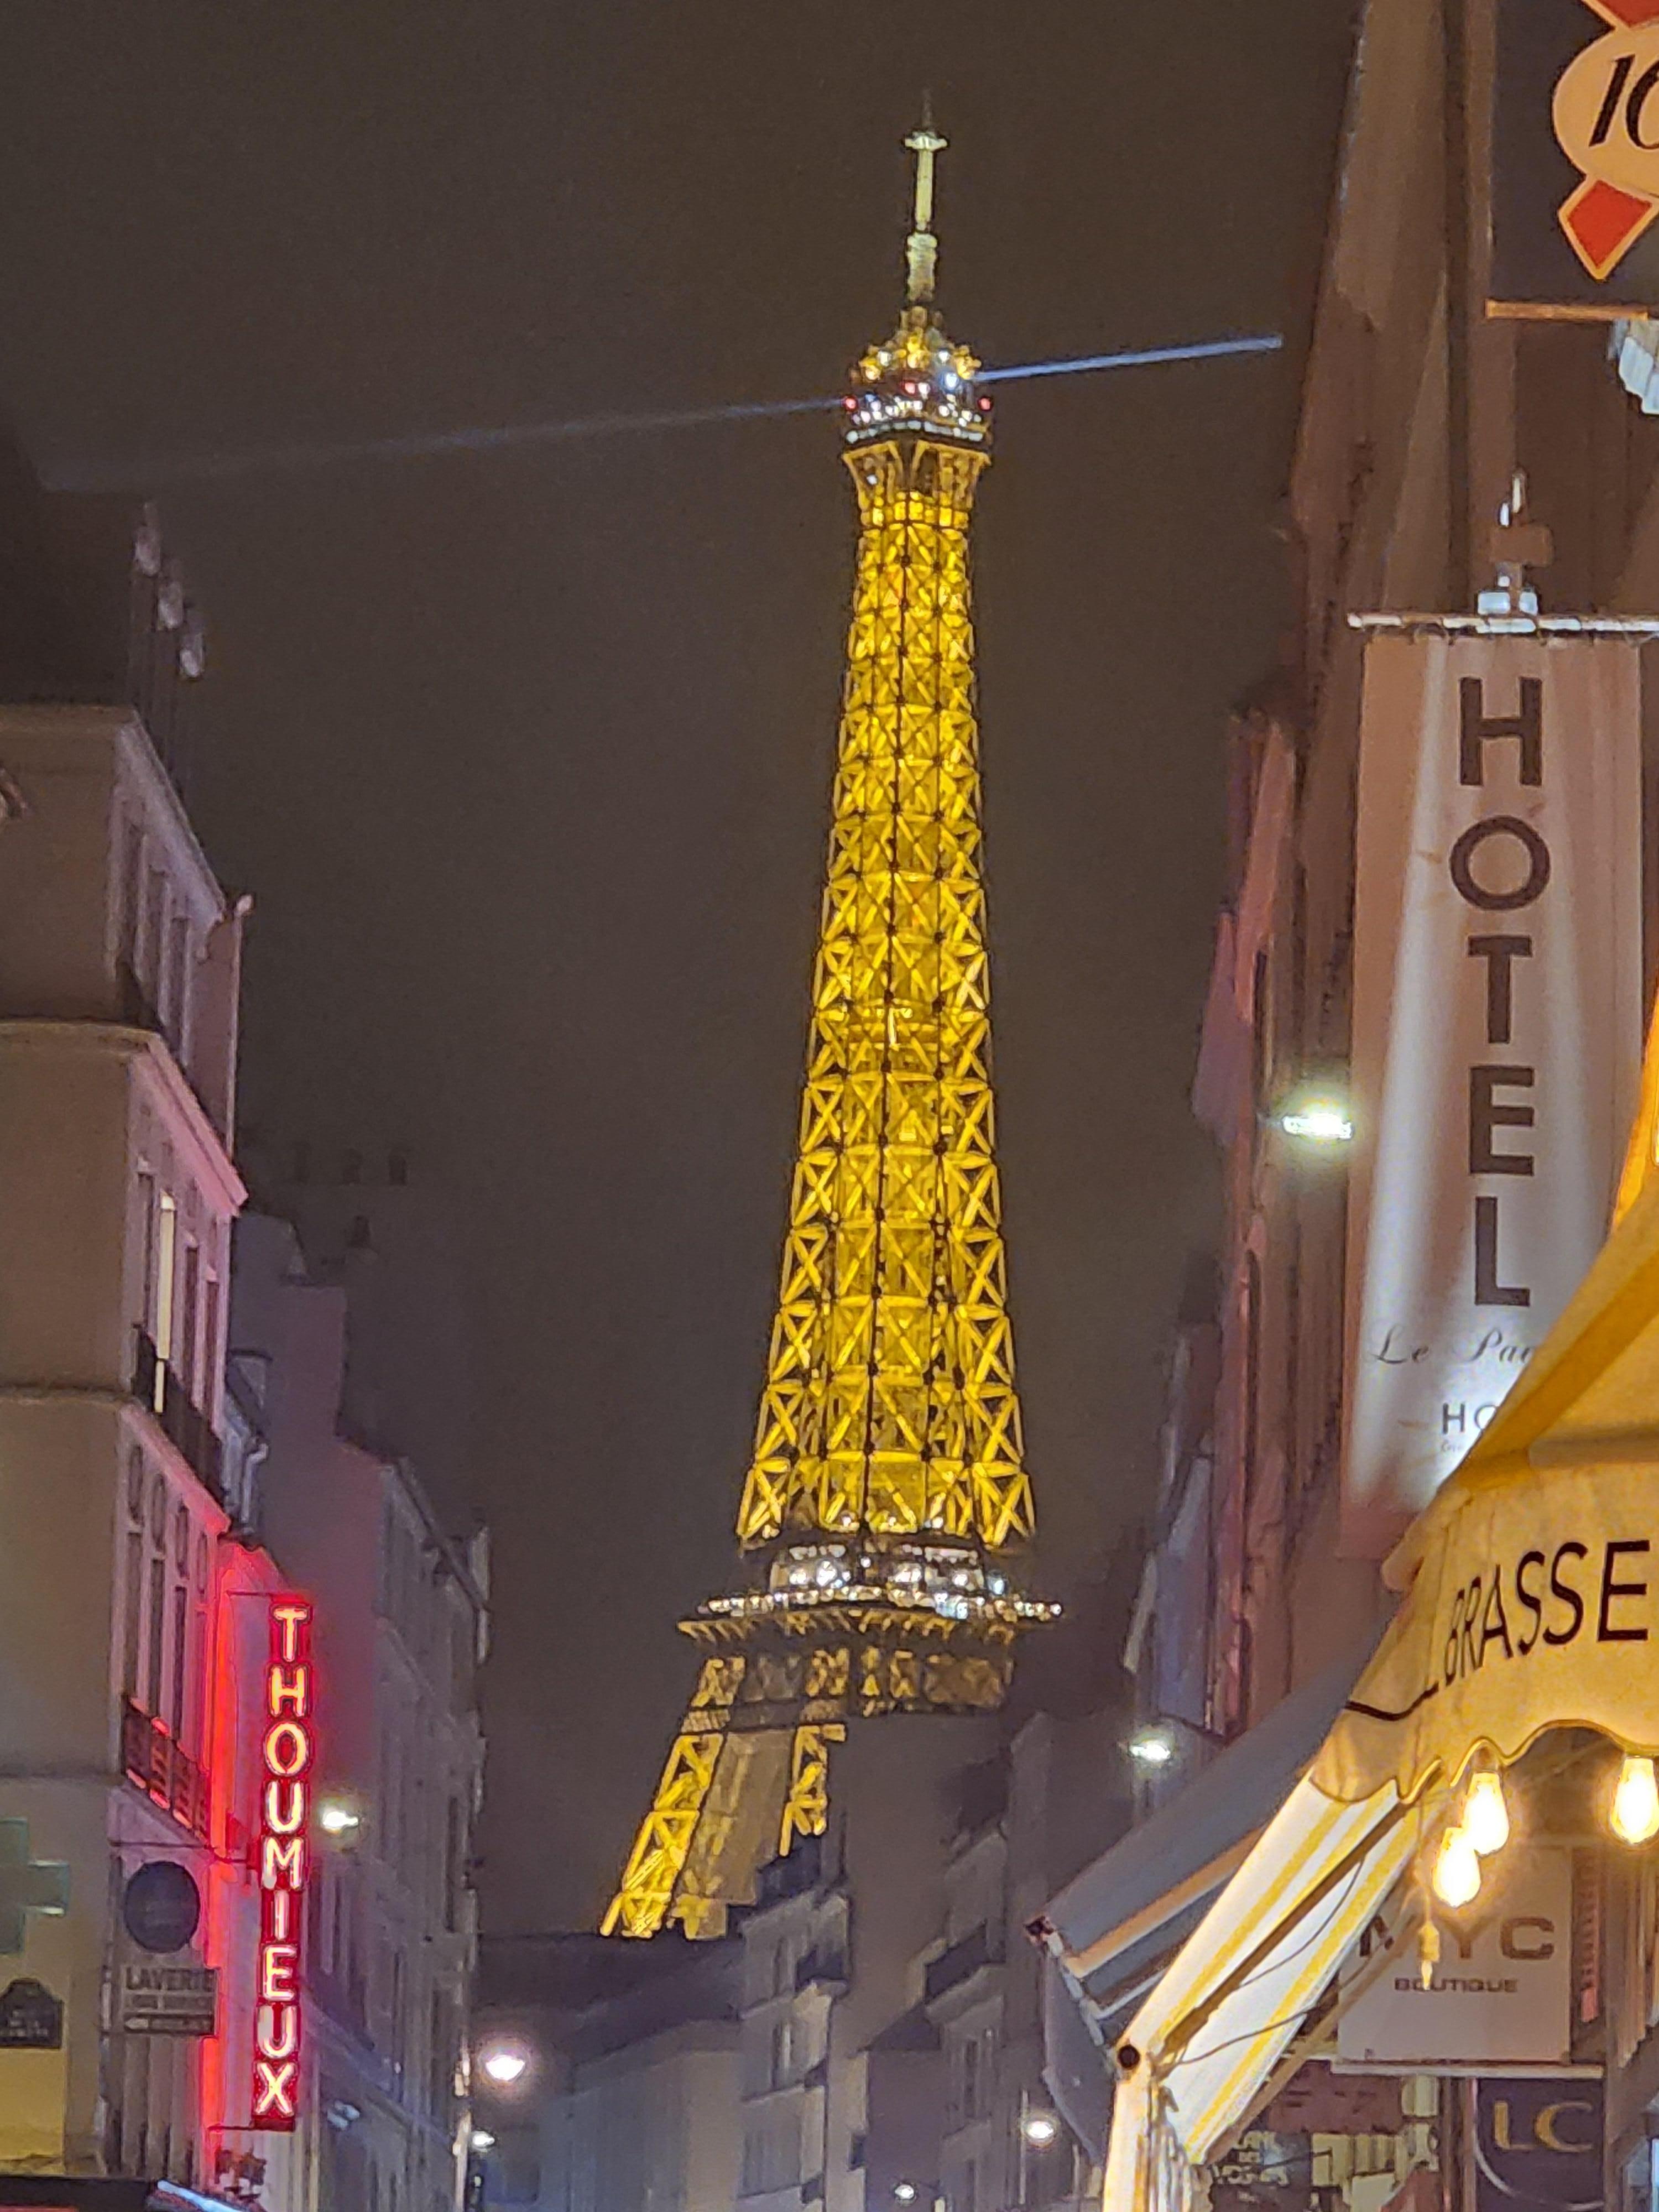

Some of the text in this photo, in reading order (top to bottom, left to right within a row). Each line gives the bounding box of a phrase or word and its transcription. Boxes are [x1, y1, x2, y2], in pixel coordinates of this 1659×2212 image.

[1449, 676, 1551, 1307] HOTEL
[1374, 1324, 1429, 1364] Le
[1444, 1540, 1650, 1687] BRASSE
[253, 1607, 310, 2116] THOUMIEUX
